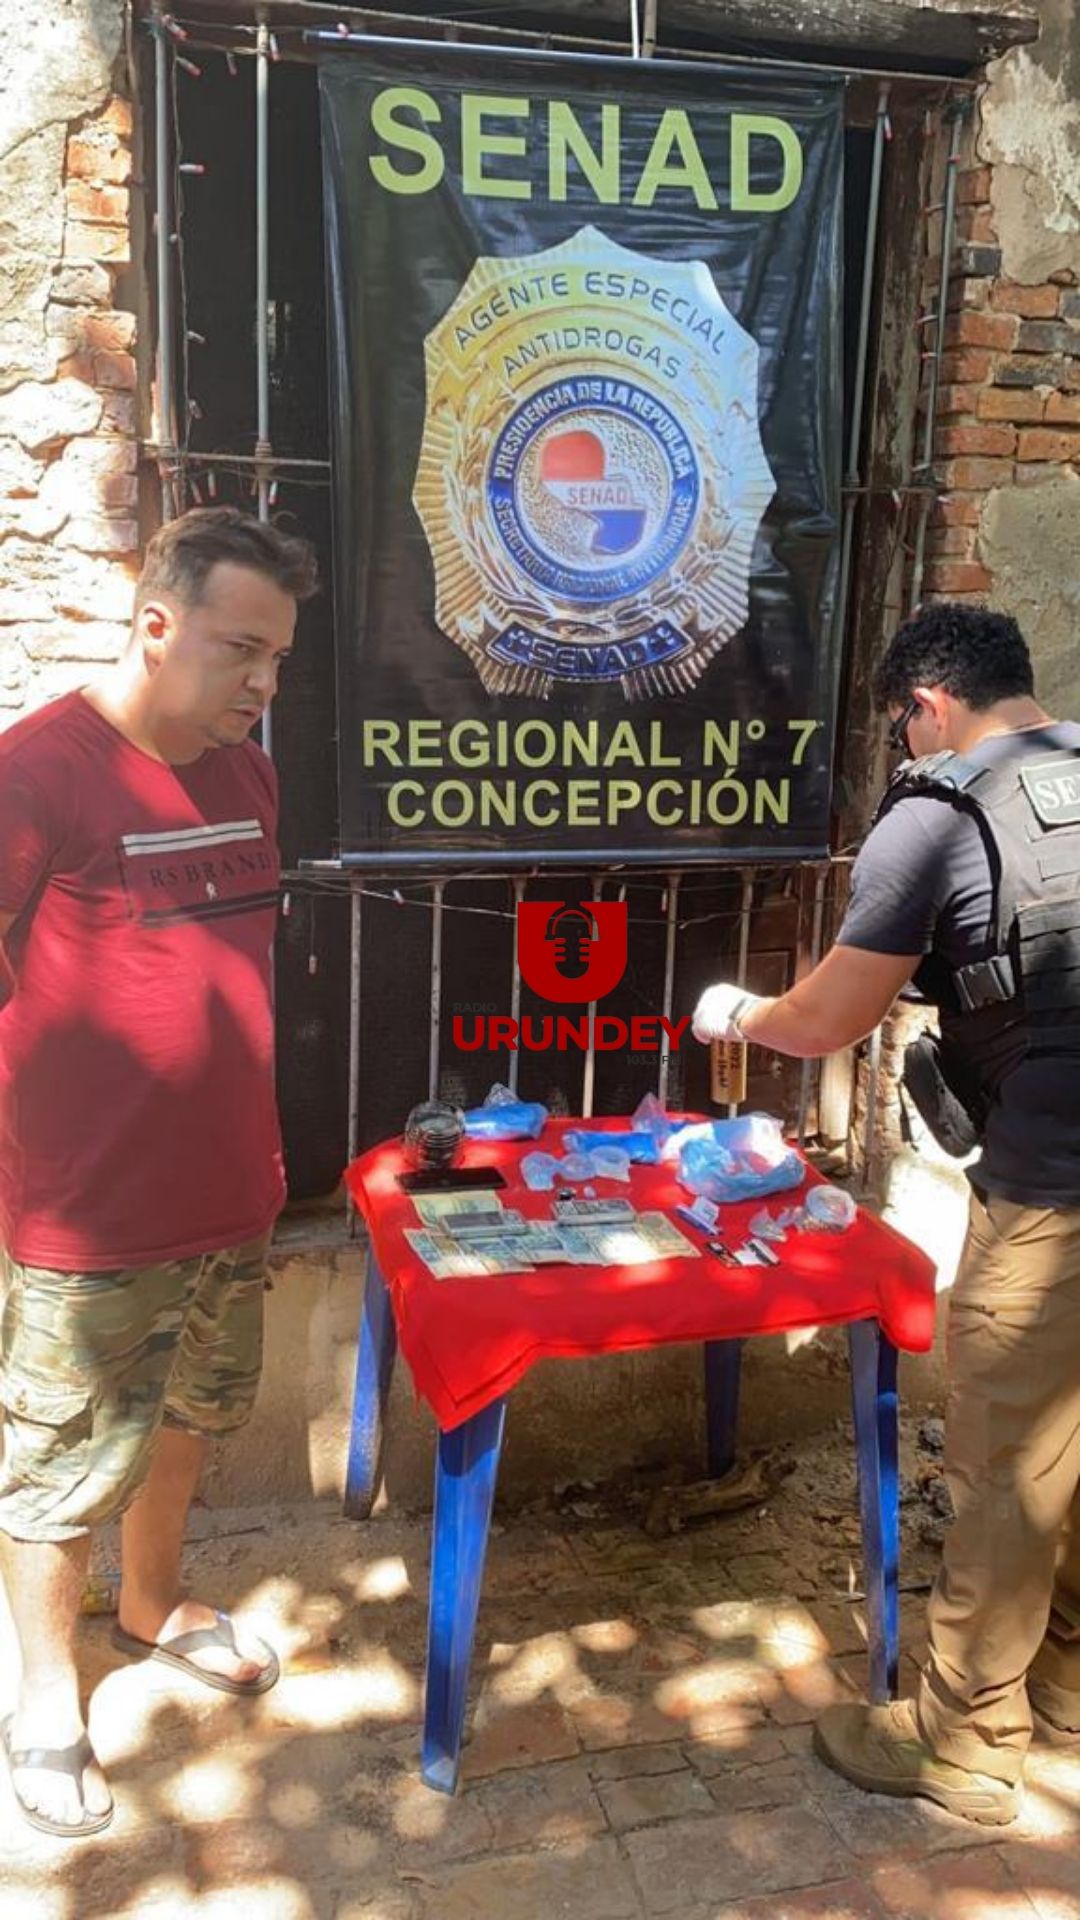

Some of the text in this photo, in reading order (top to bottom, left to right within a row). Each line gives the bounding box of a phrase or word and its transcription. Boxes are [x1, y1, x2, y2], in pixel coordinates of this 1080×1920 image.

[368, 87, 803, 213] SENAD
[454, 271, 729, 354] AGENTE ESPECIAL
[503, 327, 686, 379] ANTIDROGAS
[494, 384, 577, 479] PRESIDENCIA
[576, 382, 602, 400] DE
[604, 382, 629, 402] LA
[568, 486, 628, 505] SENAD
[529, 636, 650, 671] SENAD
[363, 719, 682, 768] REGIONAL
[788, 719, 818, 766] 7
[387, 768, 790, 827] CONCEPCIÓN
[1034, 774, 1080, 810] SE
[149, 867, 179, 887] RS
